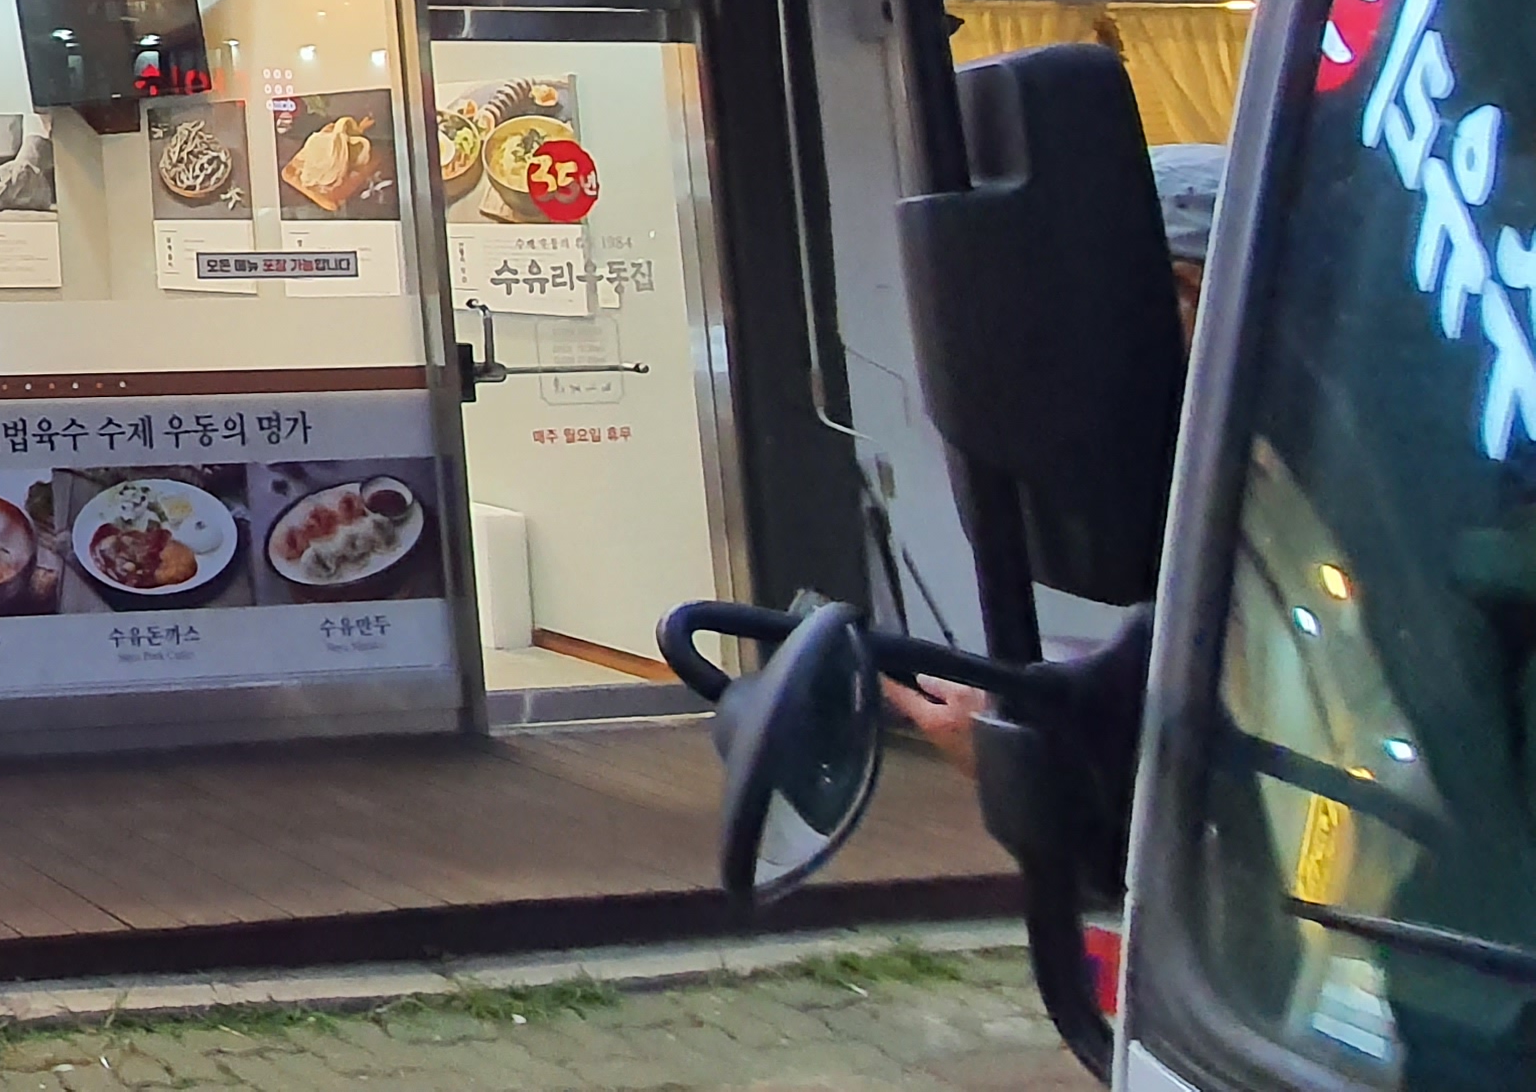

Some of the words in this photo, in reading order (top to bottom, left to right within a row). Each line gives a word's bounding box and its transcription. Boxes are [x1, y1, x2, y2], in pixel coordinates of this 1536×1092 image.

[489, 259, 656, 297] 수유리우동집
[97, 415, 156, 451] 수제
[164, 412, 247, 448] 우동의
[256, 410, 313, 446] 명가
[563, 427, 602, 444] 월요일
[108, 624, 201, 649] 수유돈까스
[319, 614, 392, 639] 수유만두
